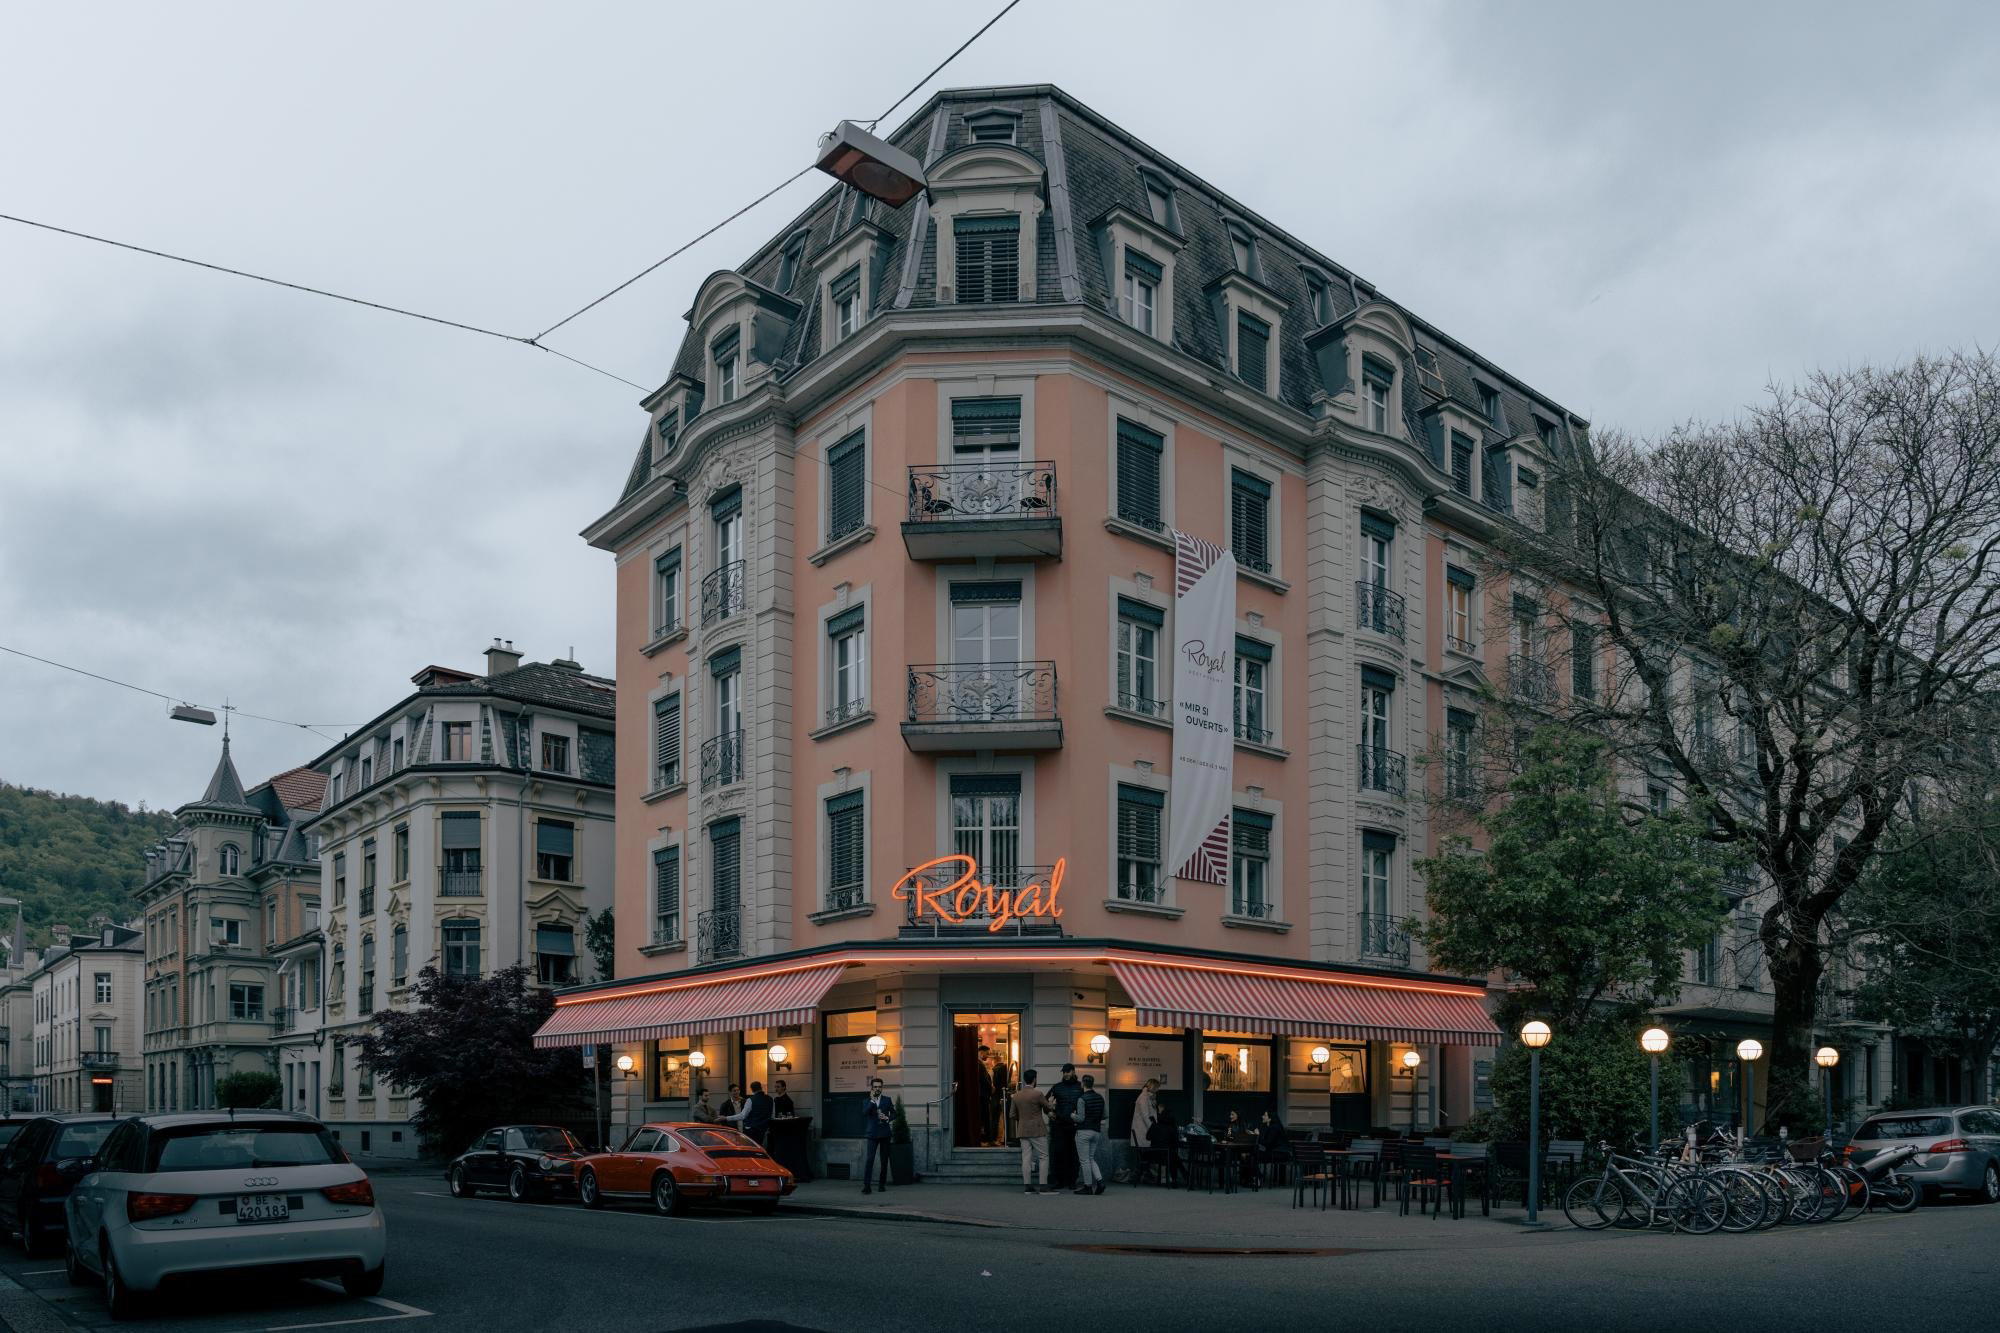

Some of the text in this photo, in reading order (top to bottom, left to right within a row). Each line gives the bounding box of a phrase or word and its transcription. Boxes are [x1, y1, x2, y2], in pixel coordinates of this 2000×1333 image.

[1181, 639, 1226, 674] Royal
[1202, 706, 1209, 717] SI
[891, 854, 1066, 933] Royal
[255, 1196, 269, 1205] BE
[239, 1205, 287, 1218] 420 183
